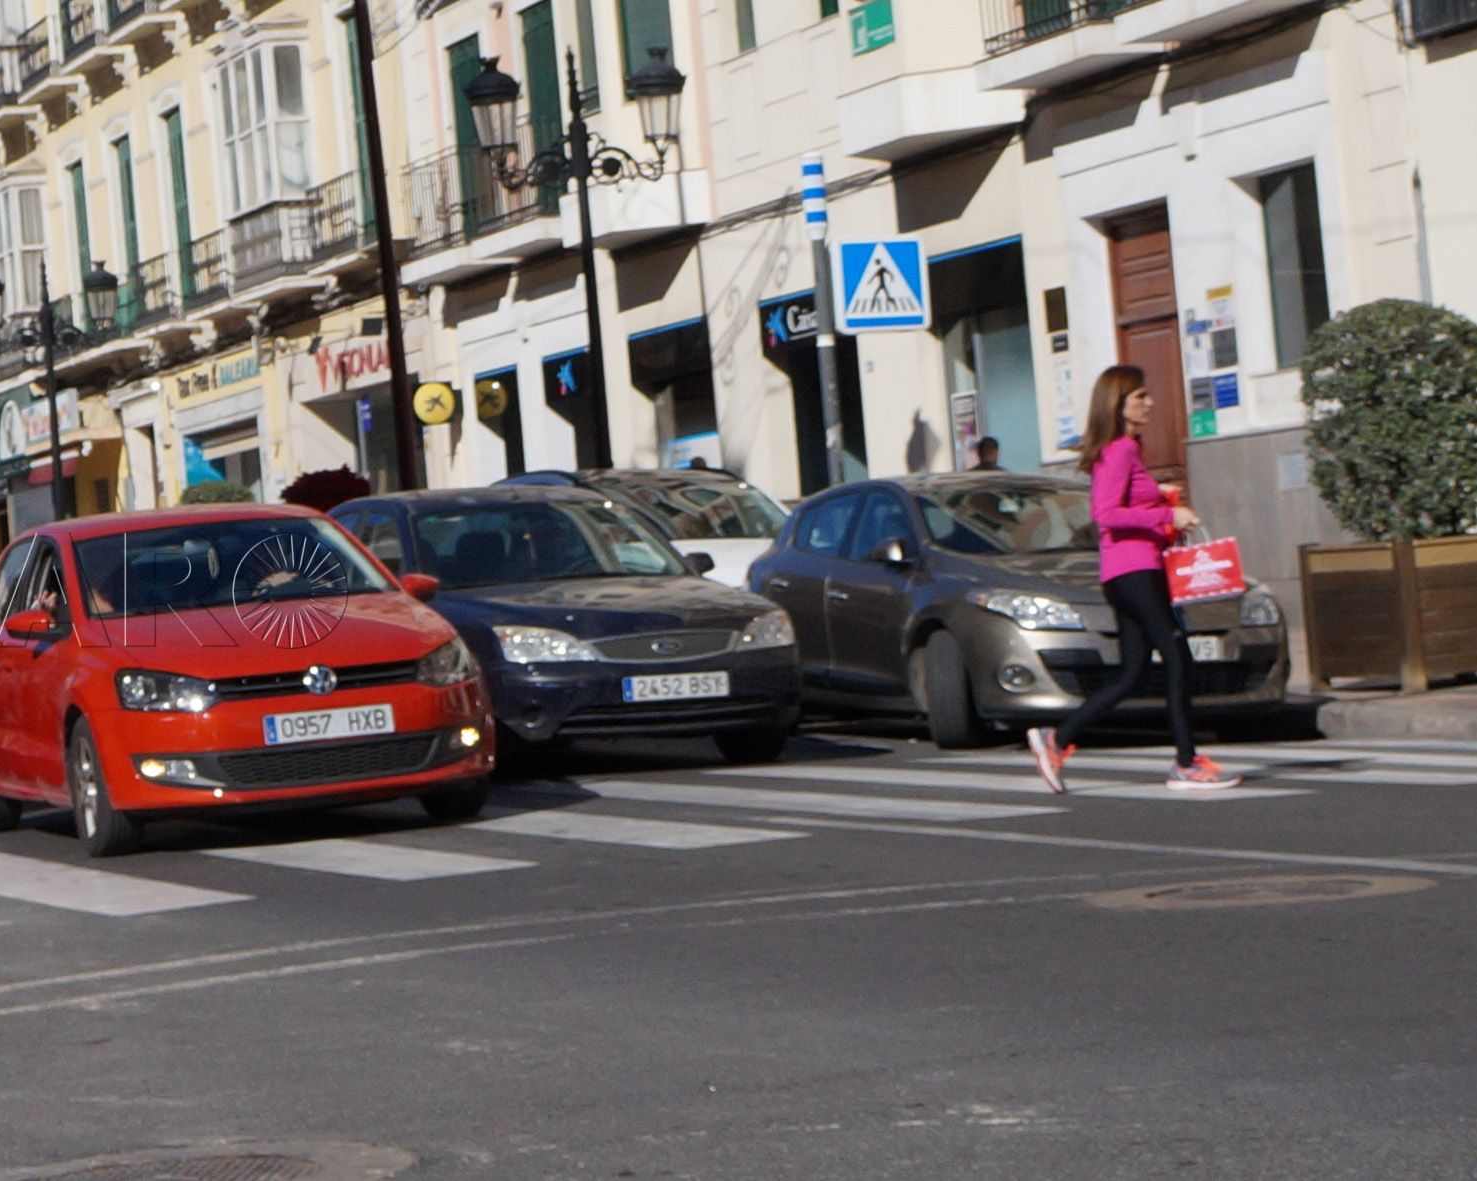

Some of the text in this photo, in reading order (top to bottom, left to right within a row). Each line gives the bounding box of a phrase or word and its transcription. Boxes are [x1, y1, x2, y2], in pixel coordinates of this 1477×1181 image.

[637, 678, 683, 698] 2452
[280, 708, 387, 739] 0957 HXB
